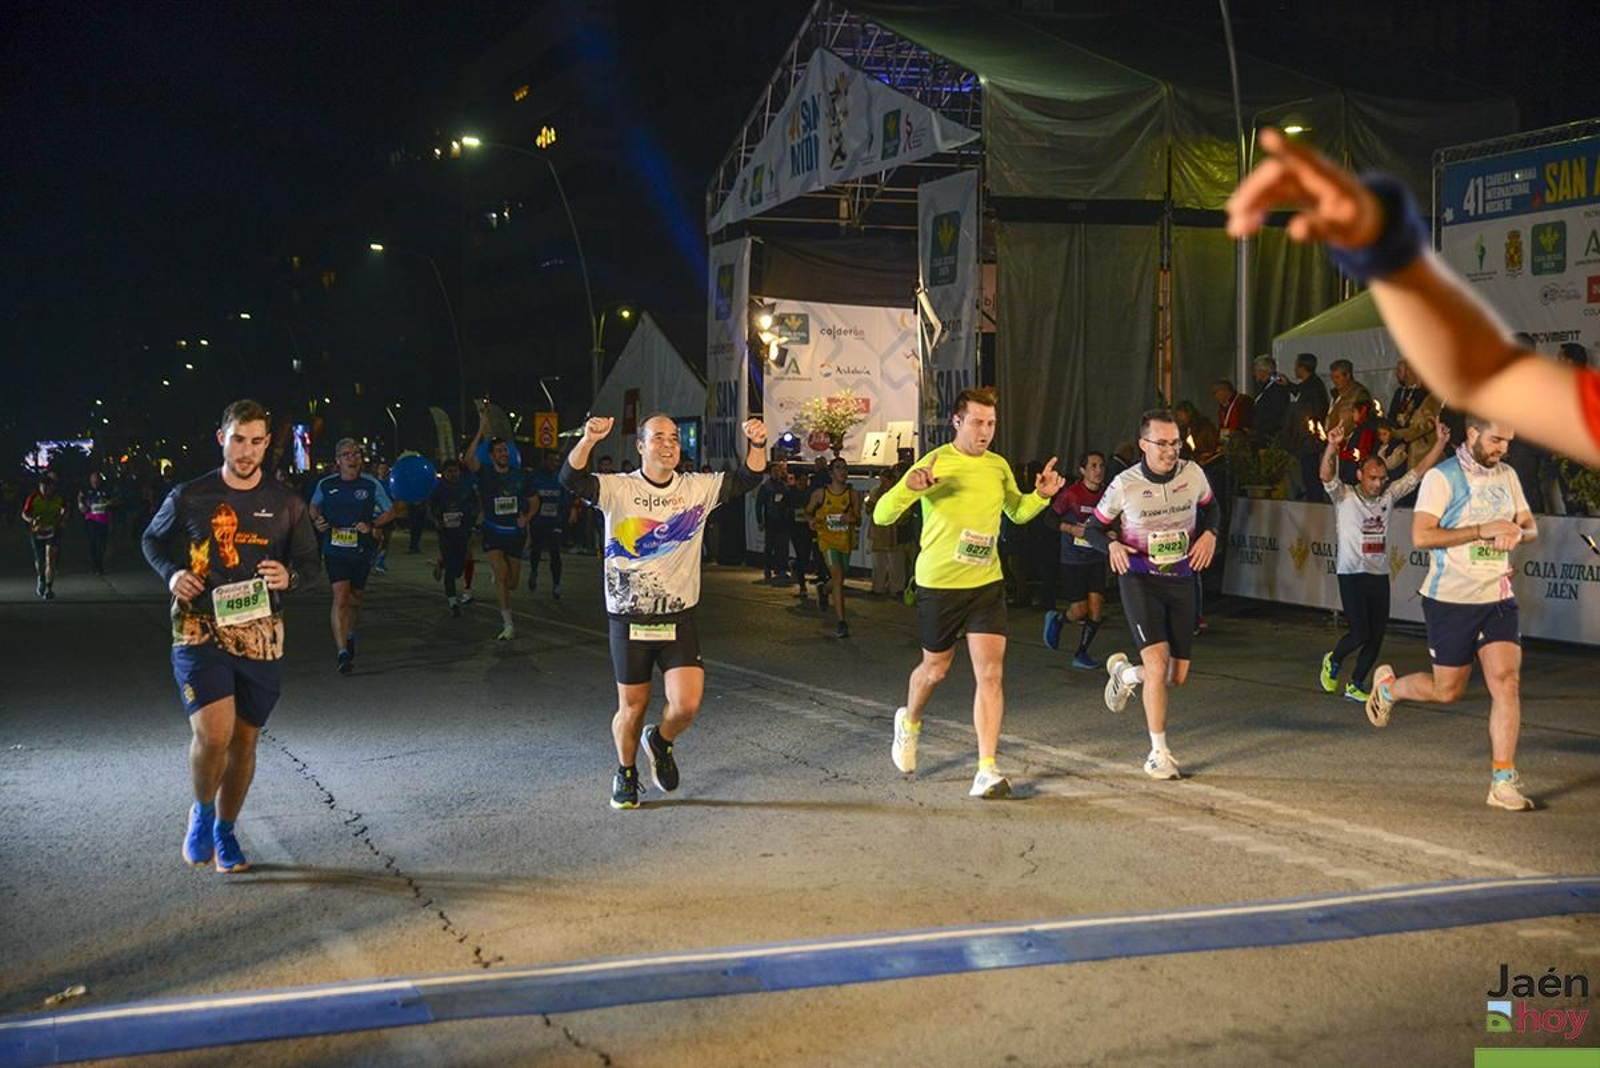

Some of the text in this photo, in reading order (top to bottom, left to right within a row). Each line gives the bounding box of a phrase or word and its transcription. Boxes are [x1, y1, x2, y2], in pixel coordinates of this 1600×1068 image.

[1545, 157, 1587, 203] SAN
[1463, 176, 1484, 216] 41
[872, 439, 880, 456] 2
[1524, 560, 1557, 579] CAJA
[1545, 580, 1579, 600] JAÉN
[226, 594, 259, 610] 4989
